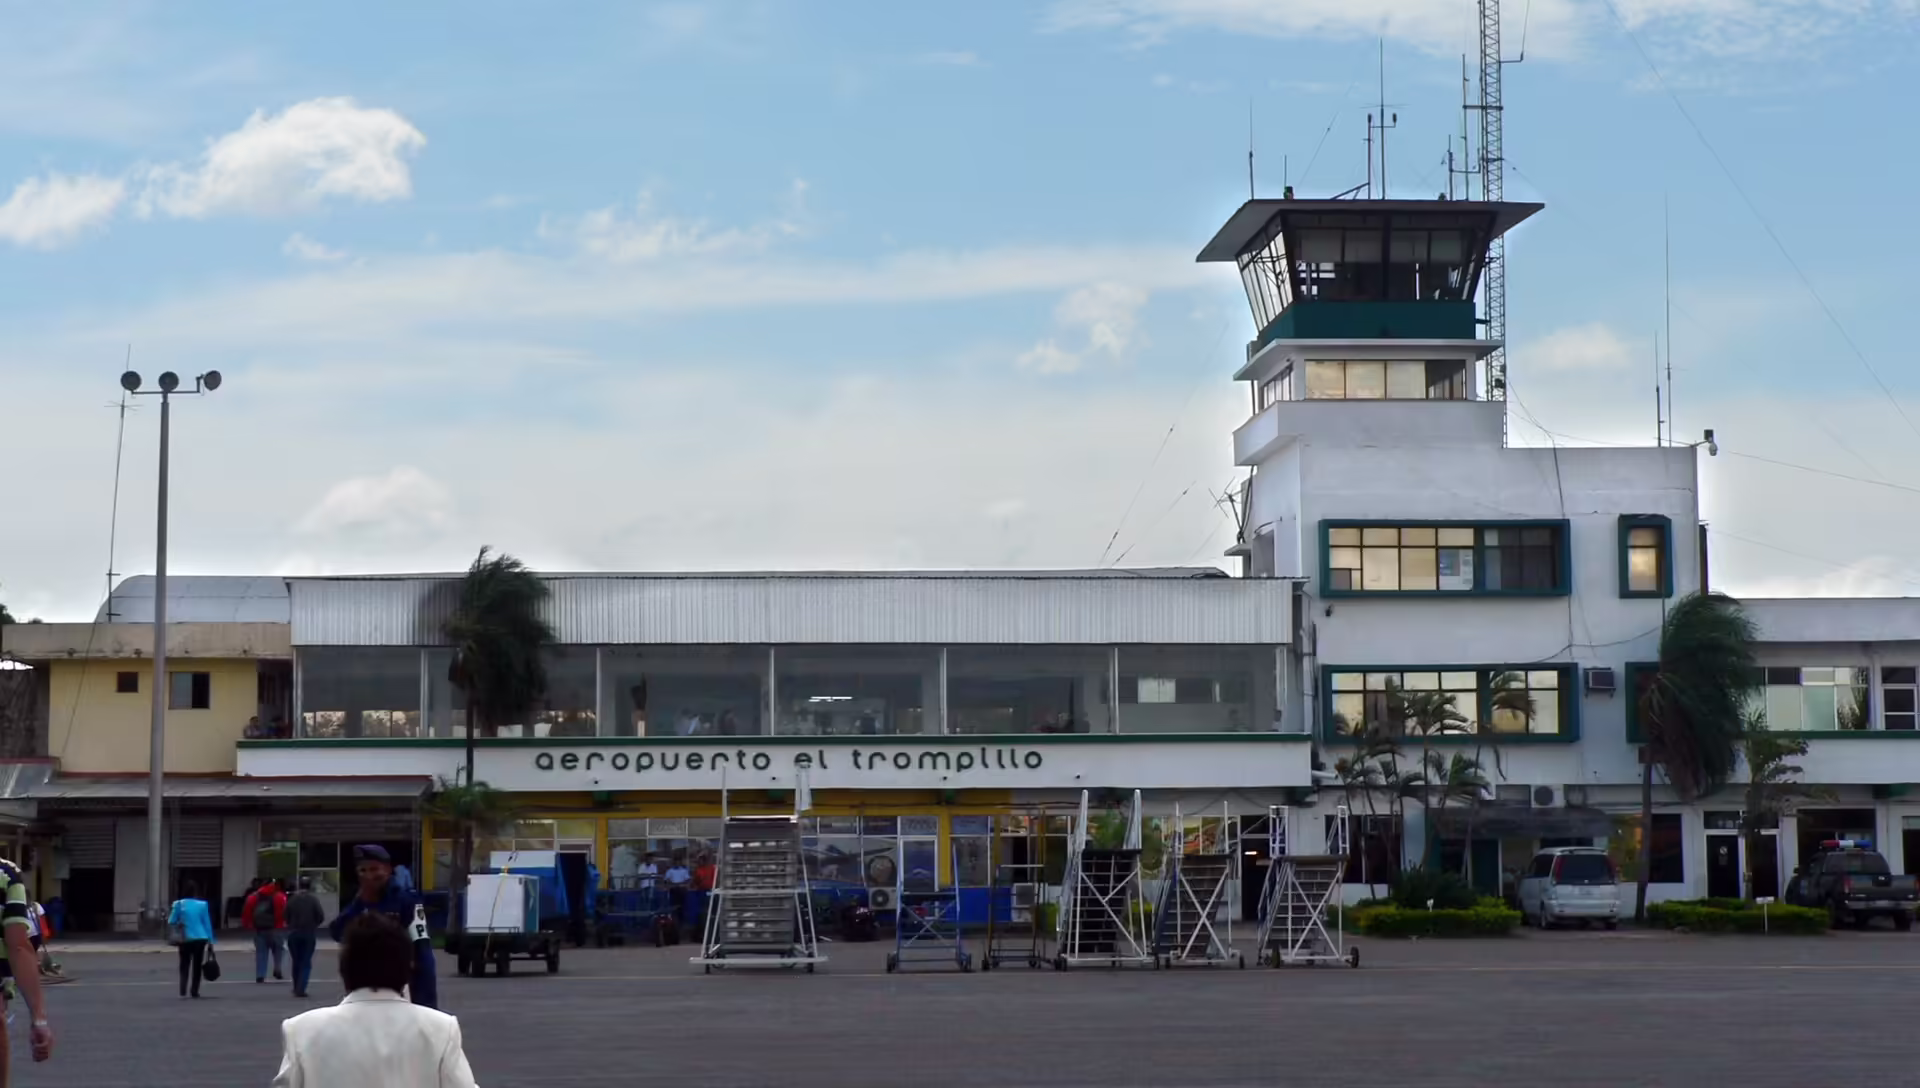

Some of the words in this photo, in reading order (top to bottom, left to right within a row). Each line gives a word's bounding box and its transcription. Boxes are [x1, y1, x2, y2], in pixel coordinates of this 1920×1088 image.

[535, 749, 771, 773] aeropuerto
[794, 749, 828, 770] el
[852, 747, 1043, 773] trompillo
